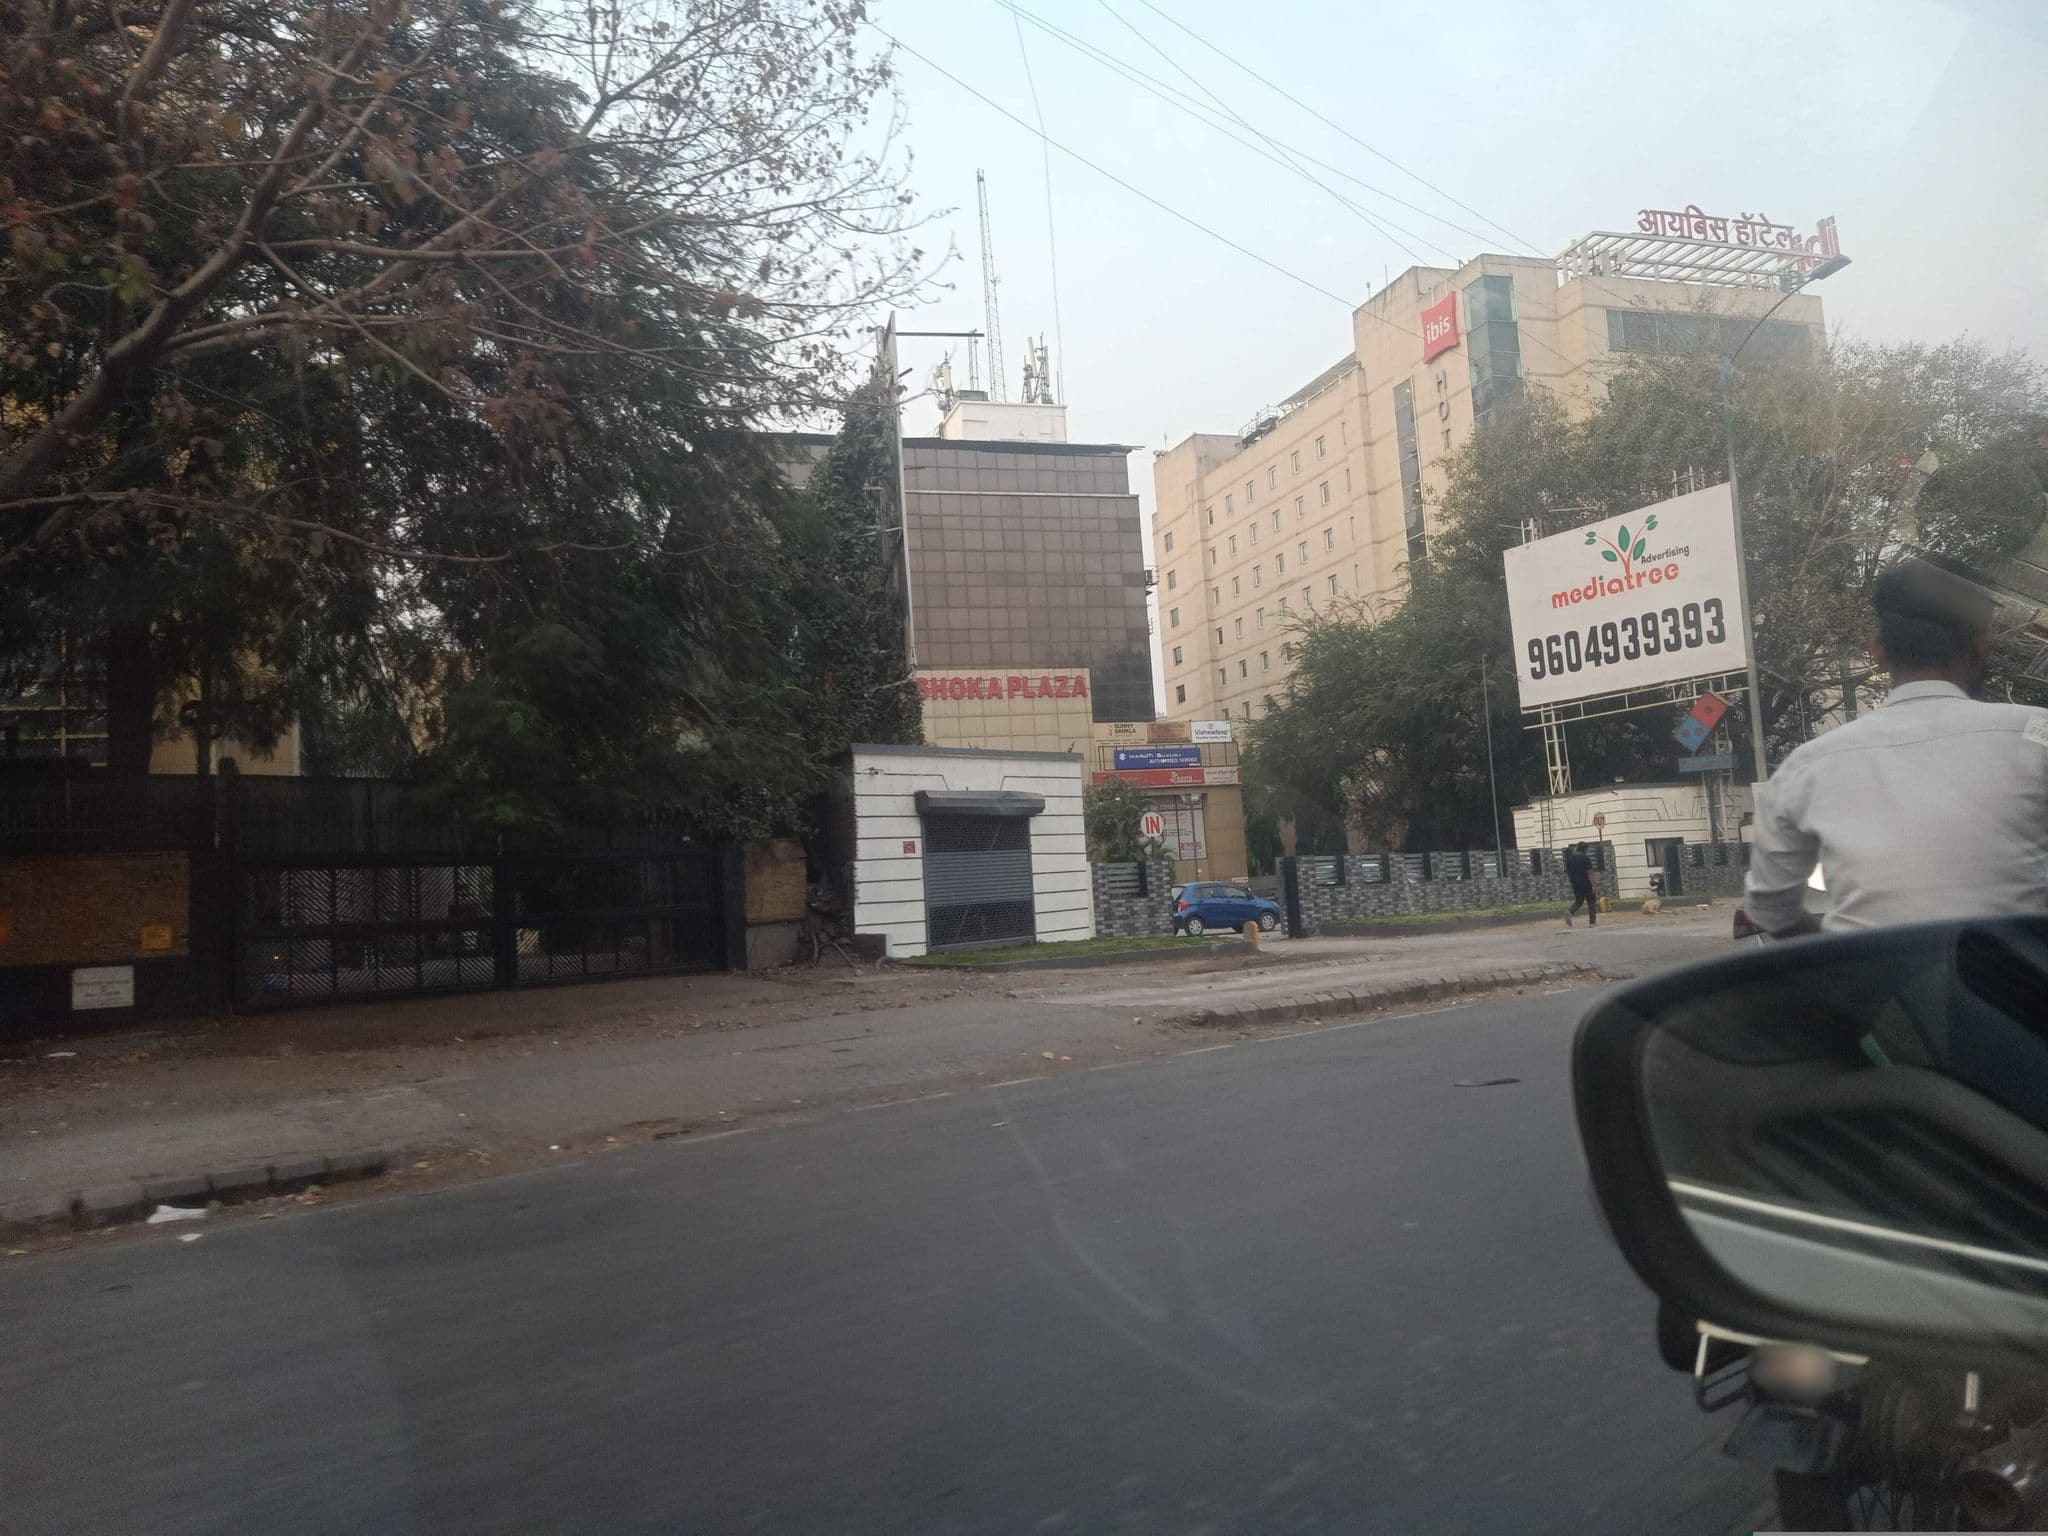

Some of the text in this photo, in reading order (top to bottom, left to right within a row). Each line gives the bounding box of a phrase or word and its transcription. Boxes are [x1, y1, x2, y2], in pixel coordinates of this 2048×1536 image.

[1638, 204, 1729, 243] आयबिस
[1426, 316, 1451, 345] ibis
[1640, 544, 1689, 565] Advertising
[1551, 562, 1680, 609] mediatree
[1528, 597, 1726, 681] 9604939393
[1006, 675, 1088, 699] PLAZA
[1145, 815, 1160, 834] IN
